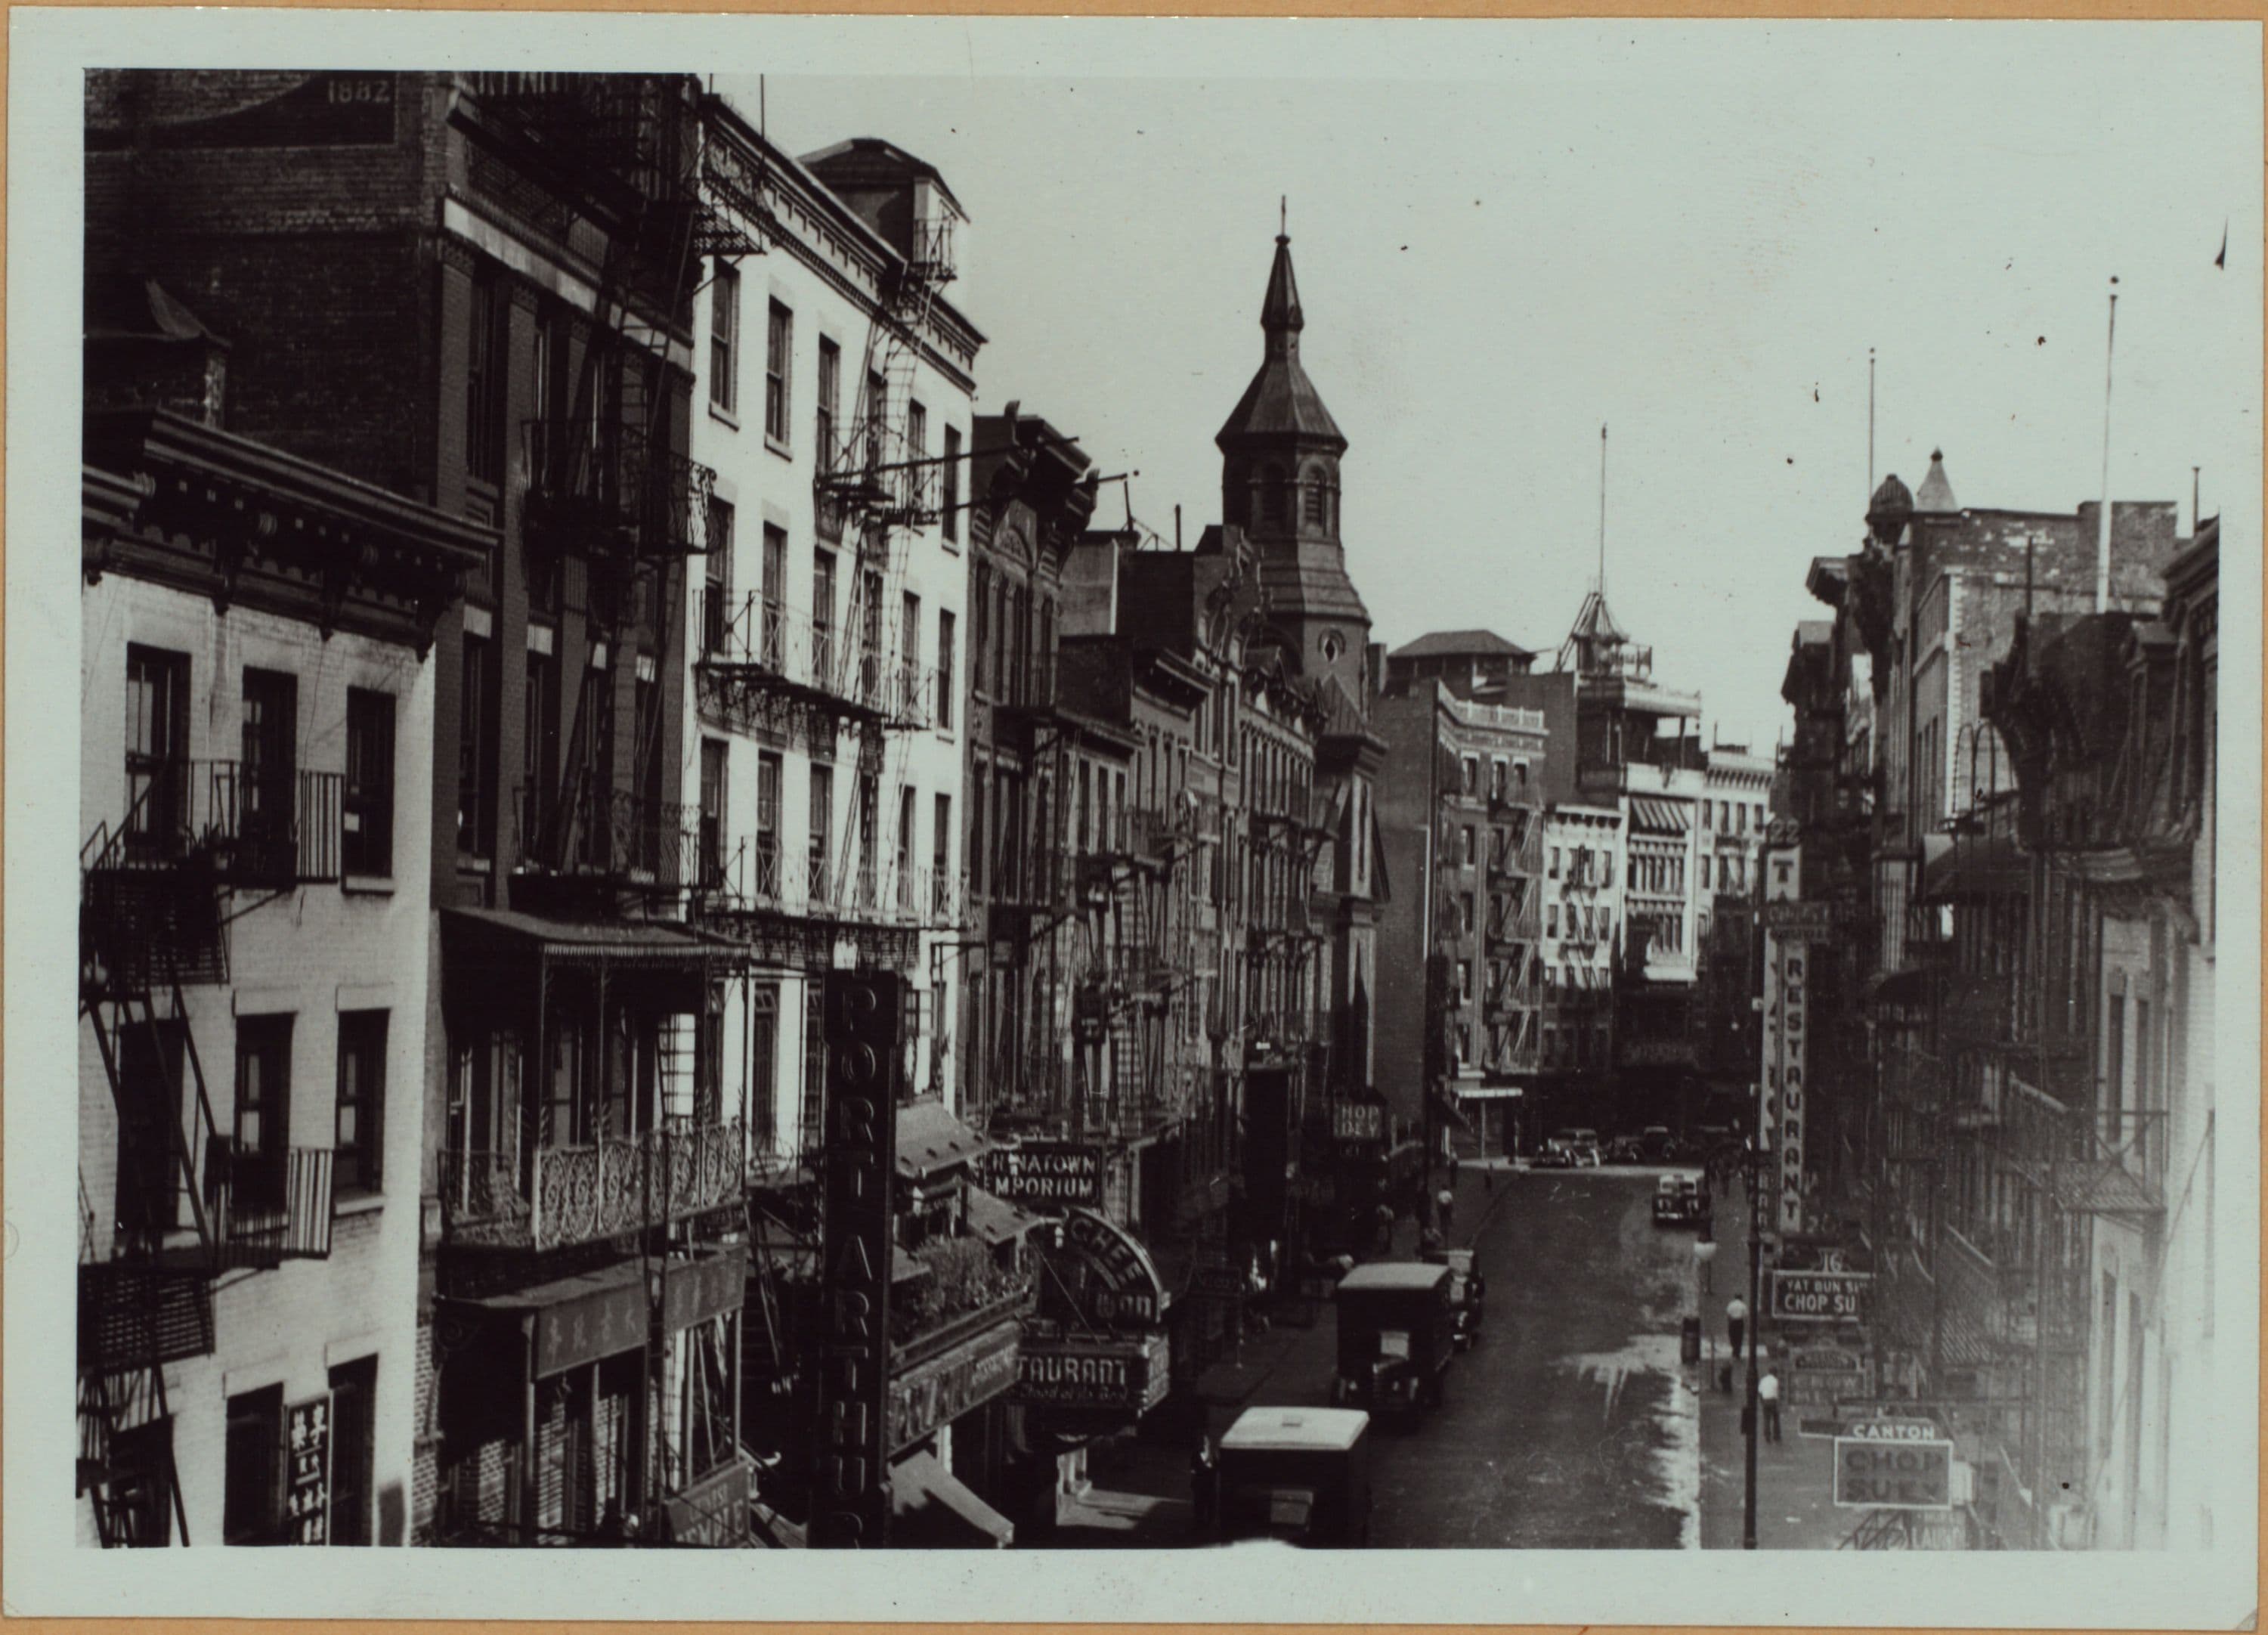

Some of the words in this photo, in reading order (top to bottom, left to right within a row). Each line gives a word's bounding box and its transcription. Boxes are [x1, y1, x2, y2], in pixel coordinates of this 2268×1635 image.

[840, 986, 877, 1197] PORT
[1785, 958, 1804, 1220] RESTAURANT
[1823, 1251, 1843, 1272] 16
[1784, 1293, 1828, 1312] CHOP
[1853, 1423, 1935, 1440] CANTON
[1846, 1451, 1943, 1472] CHOP
[1846, 1479, 1940, 1501] SUEY
